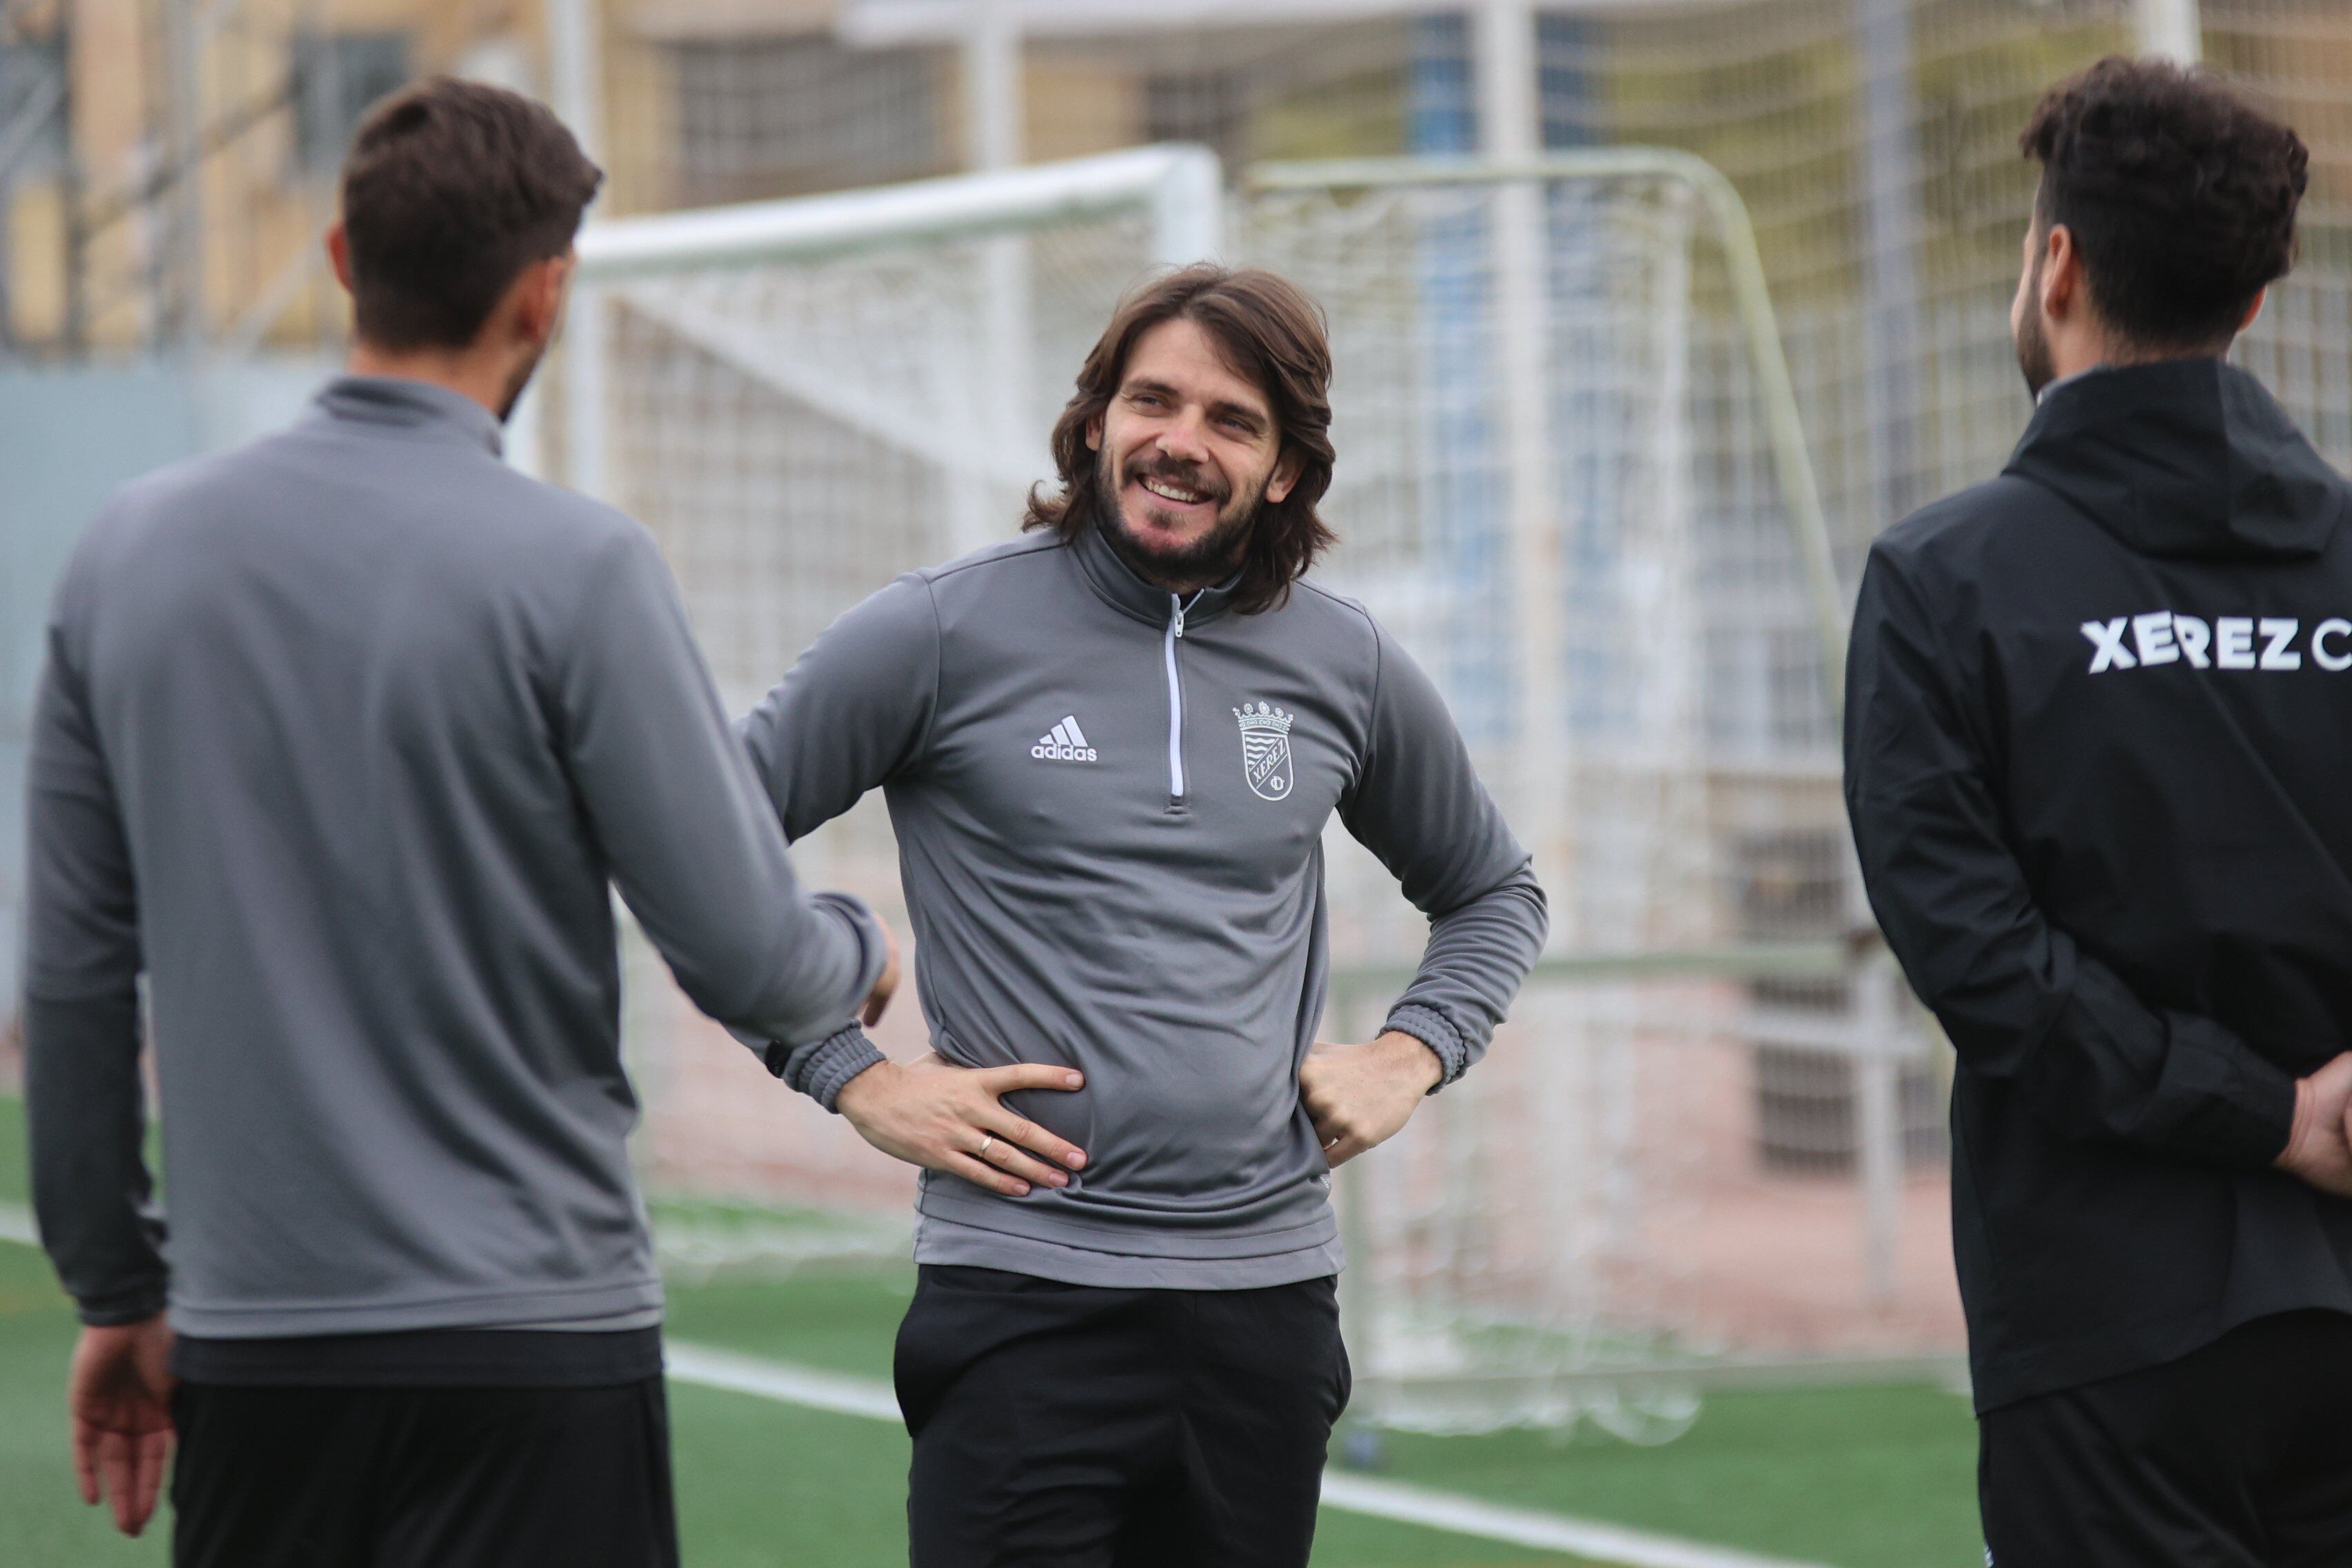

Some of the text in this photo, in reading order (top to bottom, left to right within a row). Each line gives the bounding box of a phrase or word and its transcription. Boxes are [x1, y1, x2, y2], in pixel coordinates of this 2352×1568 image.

[2080, 610, 2302, 674] XEREZ
[1030, 743, 1098, 762] adidas
[1253, 739, 1286, 783] XEREZ
